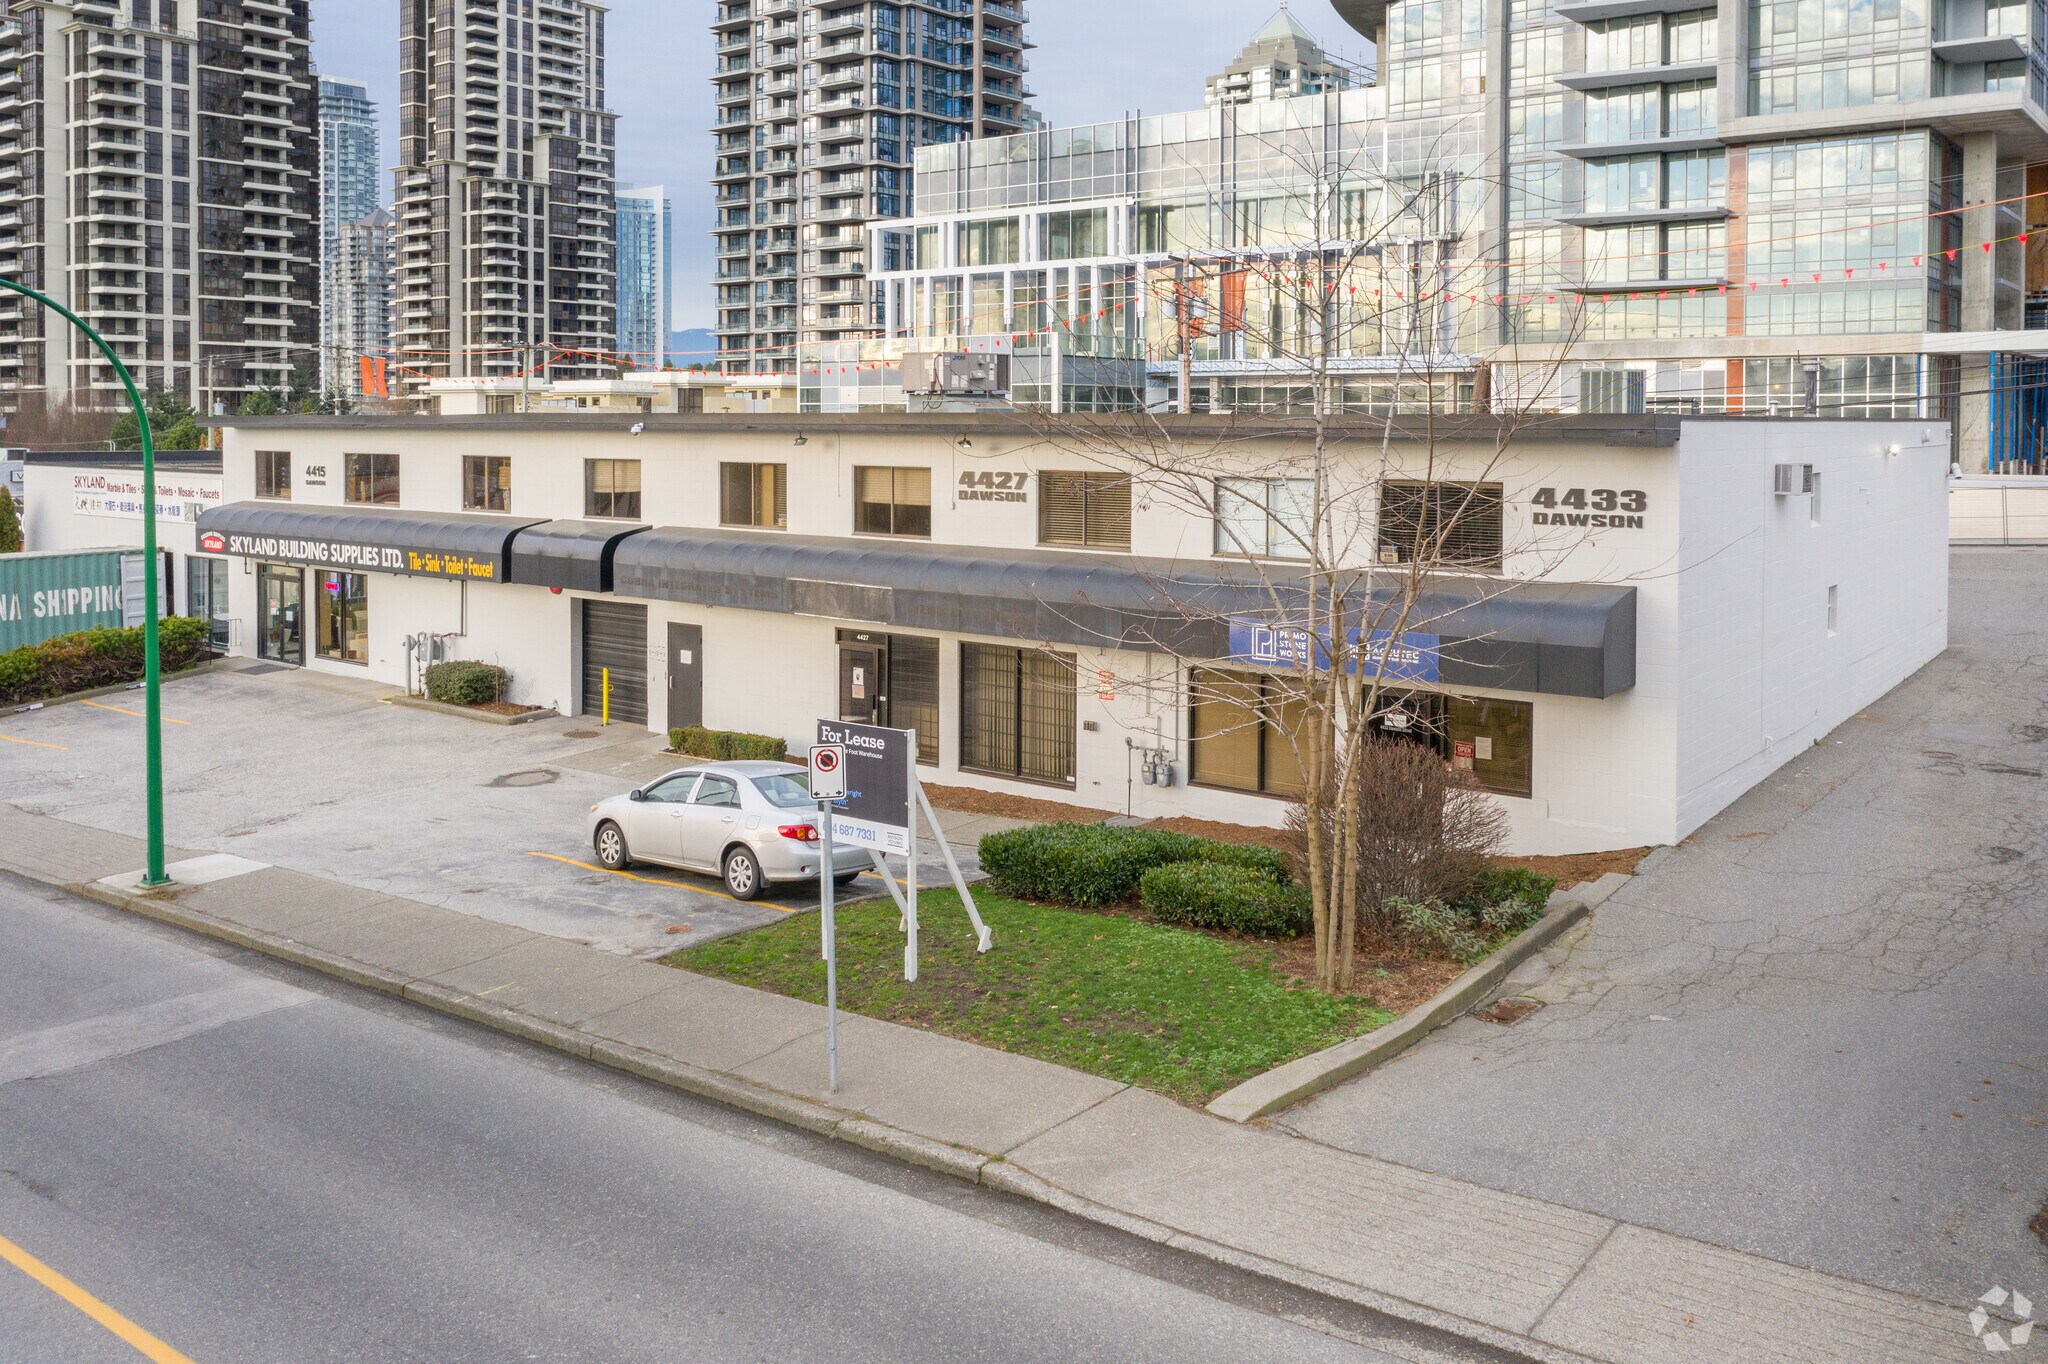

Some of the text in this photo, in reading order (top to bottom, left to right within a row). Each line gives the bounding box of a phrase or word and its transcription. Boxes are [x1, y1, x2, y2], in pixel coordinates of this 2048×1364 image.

[305, 465, 326, 477] 4415
[74, 475, 106, 489] SKYLAND
[106, 483, 121, 493] Marble
[126, 484, 136, 494] Tiles
[958, 471, 1028, 490] 4427
[158, 486, 173, 496] Toilets
[178, 487, 195, 498] Mosaic
[200, 488, 220, 500] Faucets
[958, 490, 1028, 502] DAWSON
[1531, 488, 1647, 512] 4433
[1532, 512, 1643, 529] DAWSON
[204, 539, 223, 549] SKYLAND
[230, 536, 493, 578] SKYLAND BUILDING SUPPLIES LTD. Tile Sink Toilet Faucet
[1279, 631, 1307, 640] PRMO
[1279, 649, 1307, 659] WOKS
[821, 726, 885, 749] For Lease
[859, 750, 883, 759] Warehouse
[1457, 745, 1471, 754] OPEN
[839, 824, 854, 837] 687
[856, 828, 876, 841] 7331
